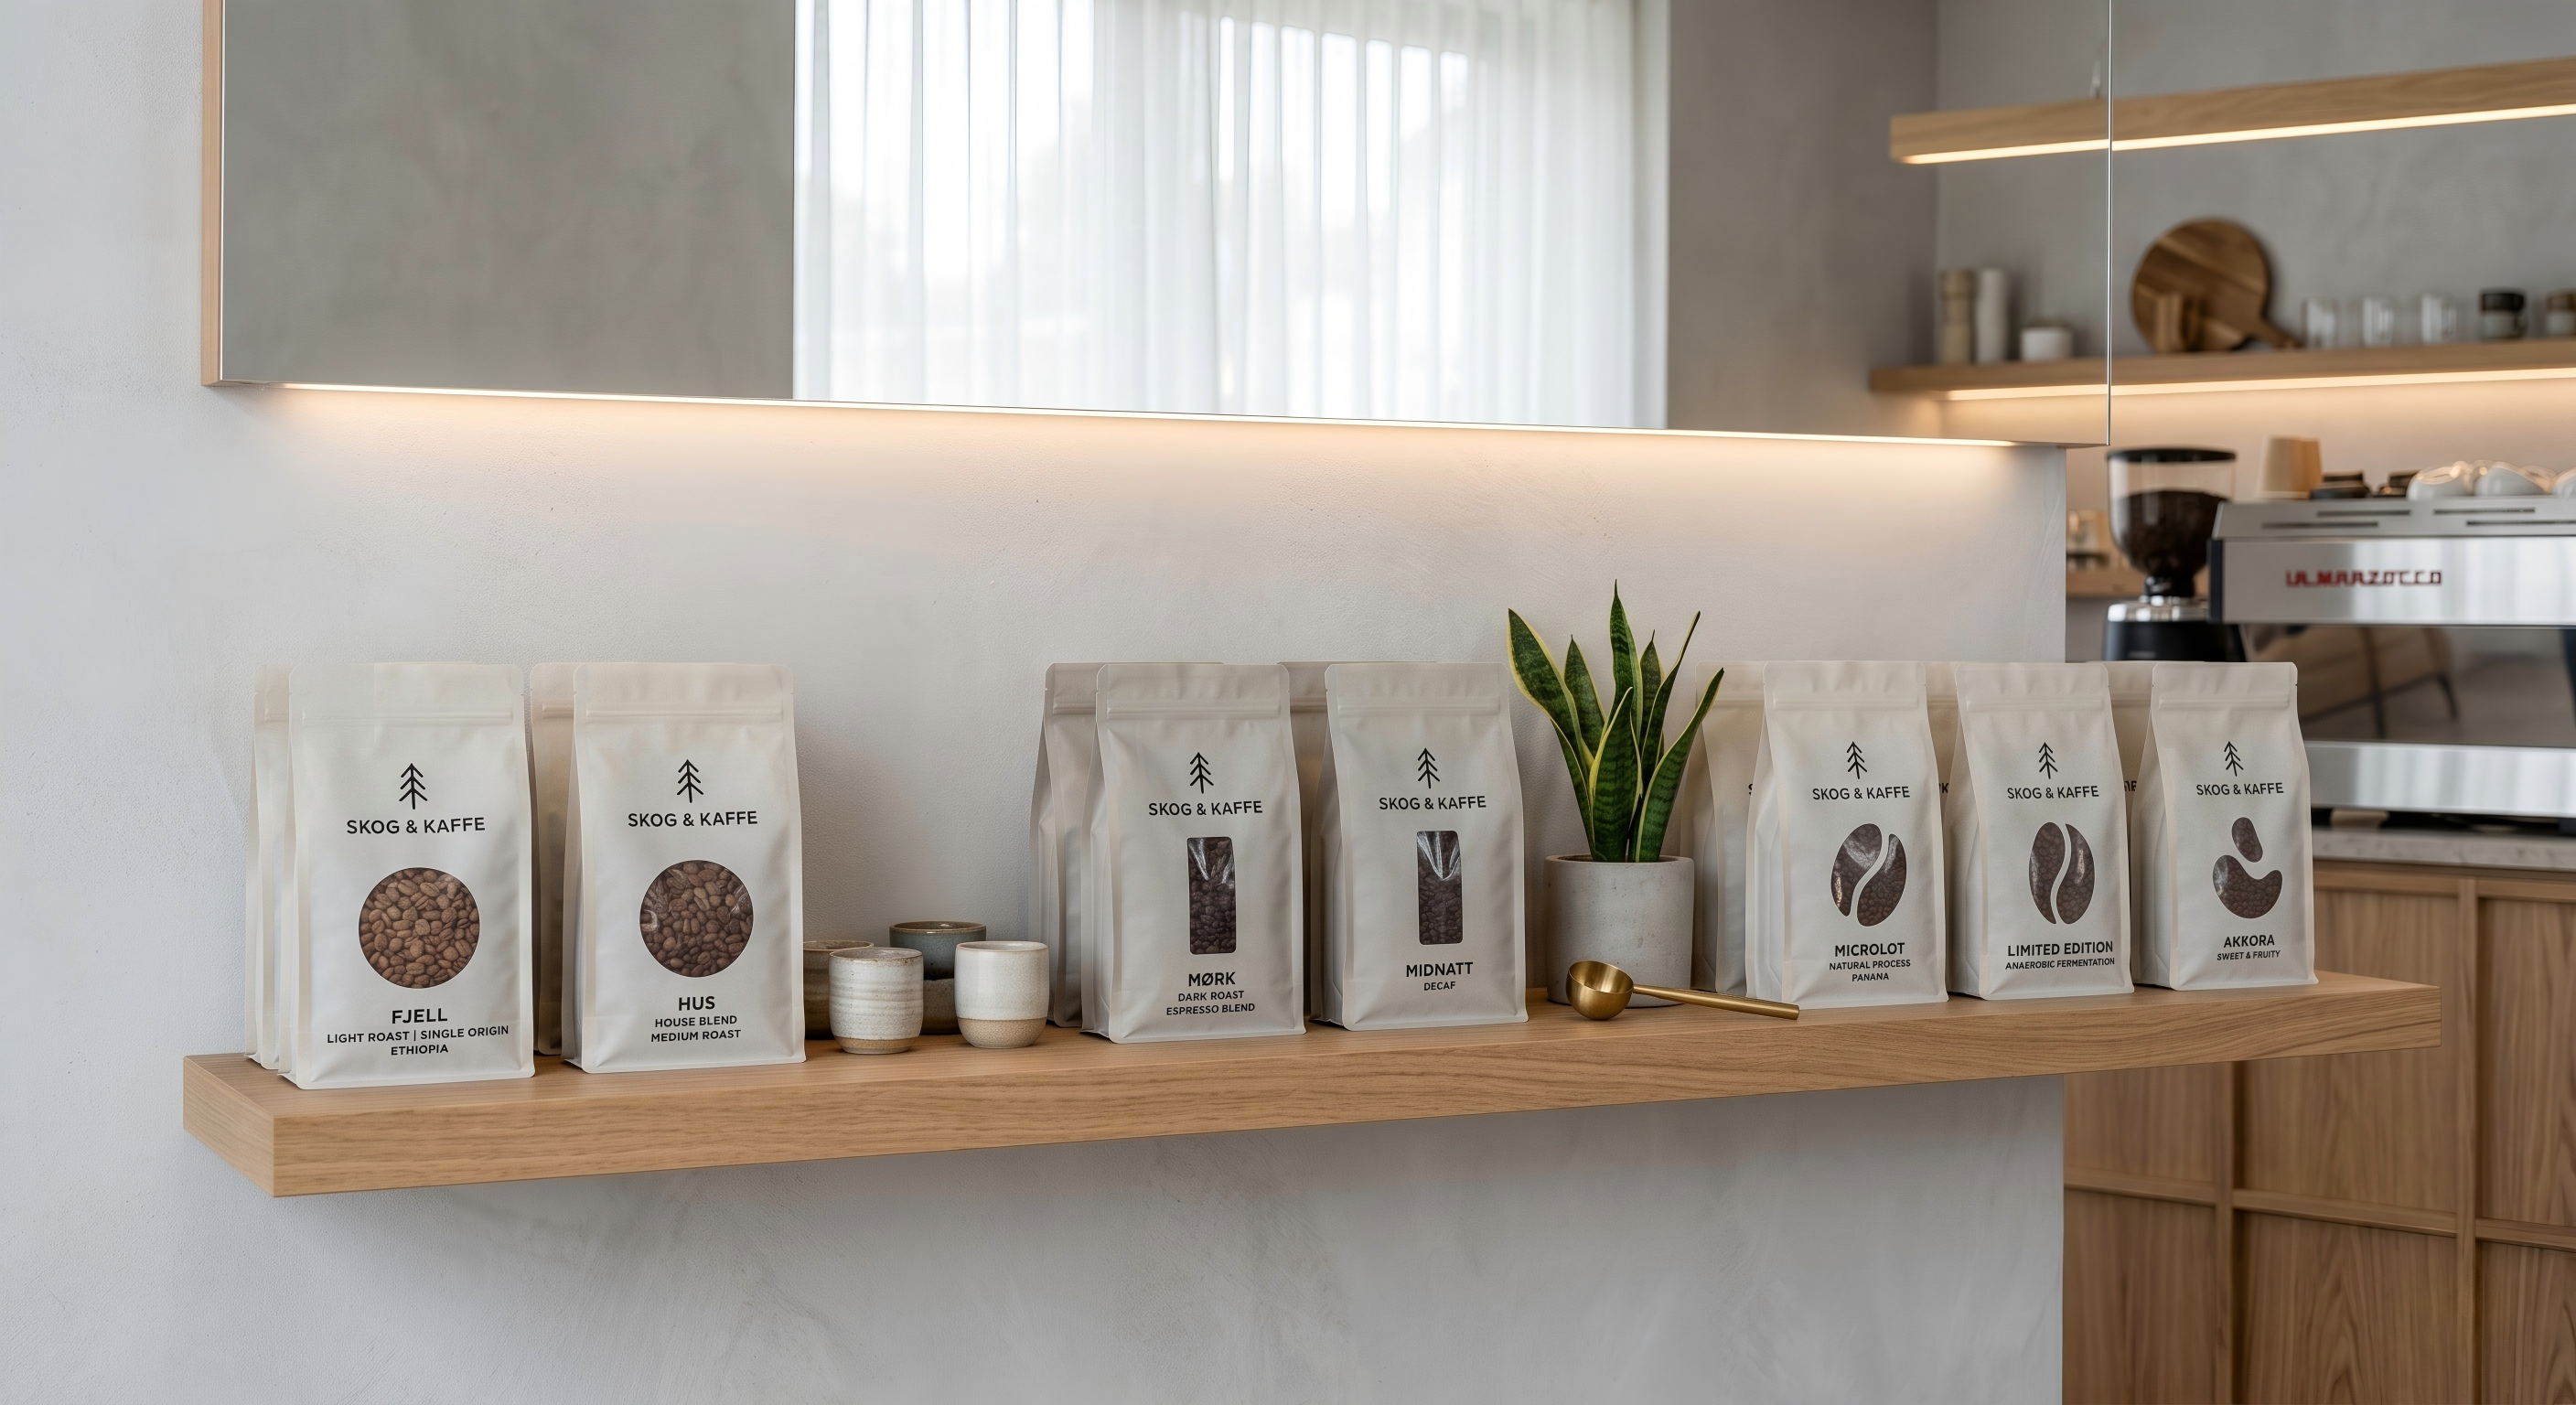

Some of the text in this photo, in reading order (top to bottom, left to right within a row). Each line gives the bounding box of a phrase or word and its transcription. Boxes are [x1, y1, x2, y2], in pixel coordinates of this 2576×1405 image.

[1812, 786, 1911, 800] SKOG & KAFFE
[2006, 785, 2099, 799] SKOG & KAFFE
[2195, 782, 2284, 796] SKOG & KAFFE
[1148, 800, 1263, 816] SKOG & KAFFE
[1379, 795, 1487, 810] SKOG & KAFFE
[347, 817, 486, 835] SKOG & KAFFE
[628, 810, 758, 828] SKOG & KAFFE
[2007, 940, 2113, 957] LIMITED EDITION
[2223, 934, 2275, 949] AKKORA
[1834, 941, 1905, 958] MICROLOT
[2216, 949, 2281, 961] SWEET & FRUITY
[1406, 961, 1474, 978] MIDNATT
[1829, 959, 1912, 971] NATURAL PROCESS
[2004, 957, 2115, 971] ANAEROBIC FERMENTATION
[1188, 971, 1236, 987] MØRK
[1852, 972, 1890, 982] PANANA
[1423, 981, 1456, 992] DECAF
[678, 995, 715, 1012] HUS
[1177, 990, 1245, 1003] DARK ROAST
[392, 1007, 448, 1024] FJELL
[1166, 1003, 1256, 1016] ESPRESSO BLEND
[654, 1014, 737, 1028] HOUSE BLEND
[327, 1033, 365, 1044] LIGHT
[368, 1031, 411, 1043] ROAST
[420, 1028, 465, 1040] SINGLE
[467, 1024, 509, 1037] ORIGIN
[650, 1029, 742, 1043] MEDIUM ROAST
[391, 1044, 449, 1056] ETHIOPIA
